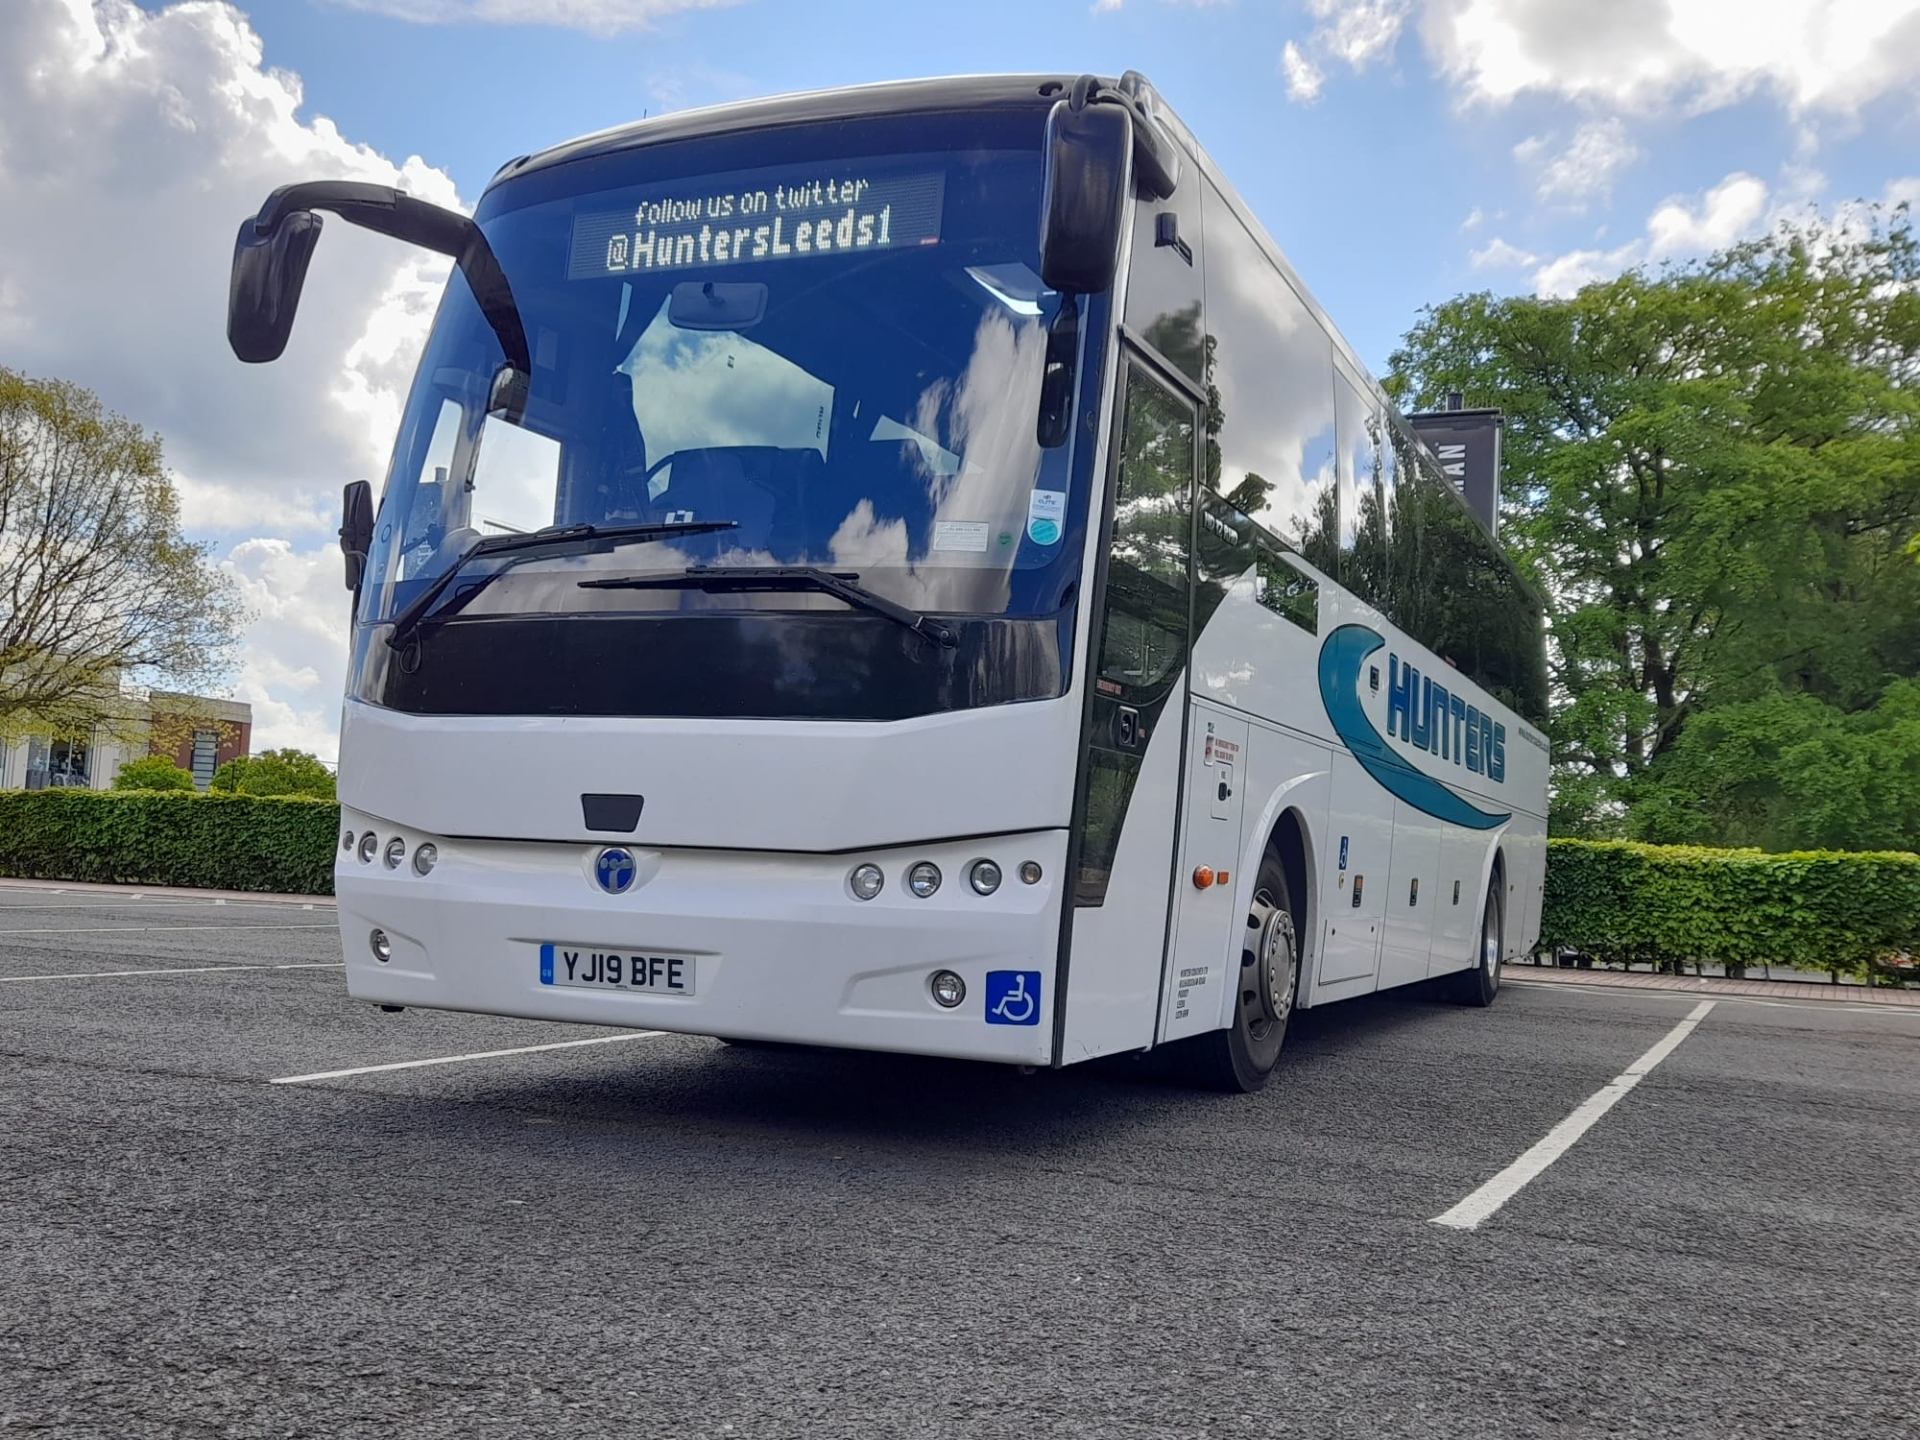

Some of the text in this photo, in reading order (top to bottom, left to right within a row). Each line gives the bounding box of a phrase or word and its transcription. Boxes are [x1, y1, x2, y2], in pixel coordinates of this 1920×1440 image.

[635, 178, 870, 226] follow us on twitter
[605, 203, 891, 271] @HuntersLeeds1
[1387, 652, 1506, 784] HUNTERS
[563, 951, 684, 989] YJ19 BFE
